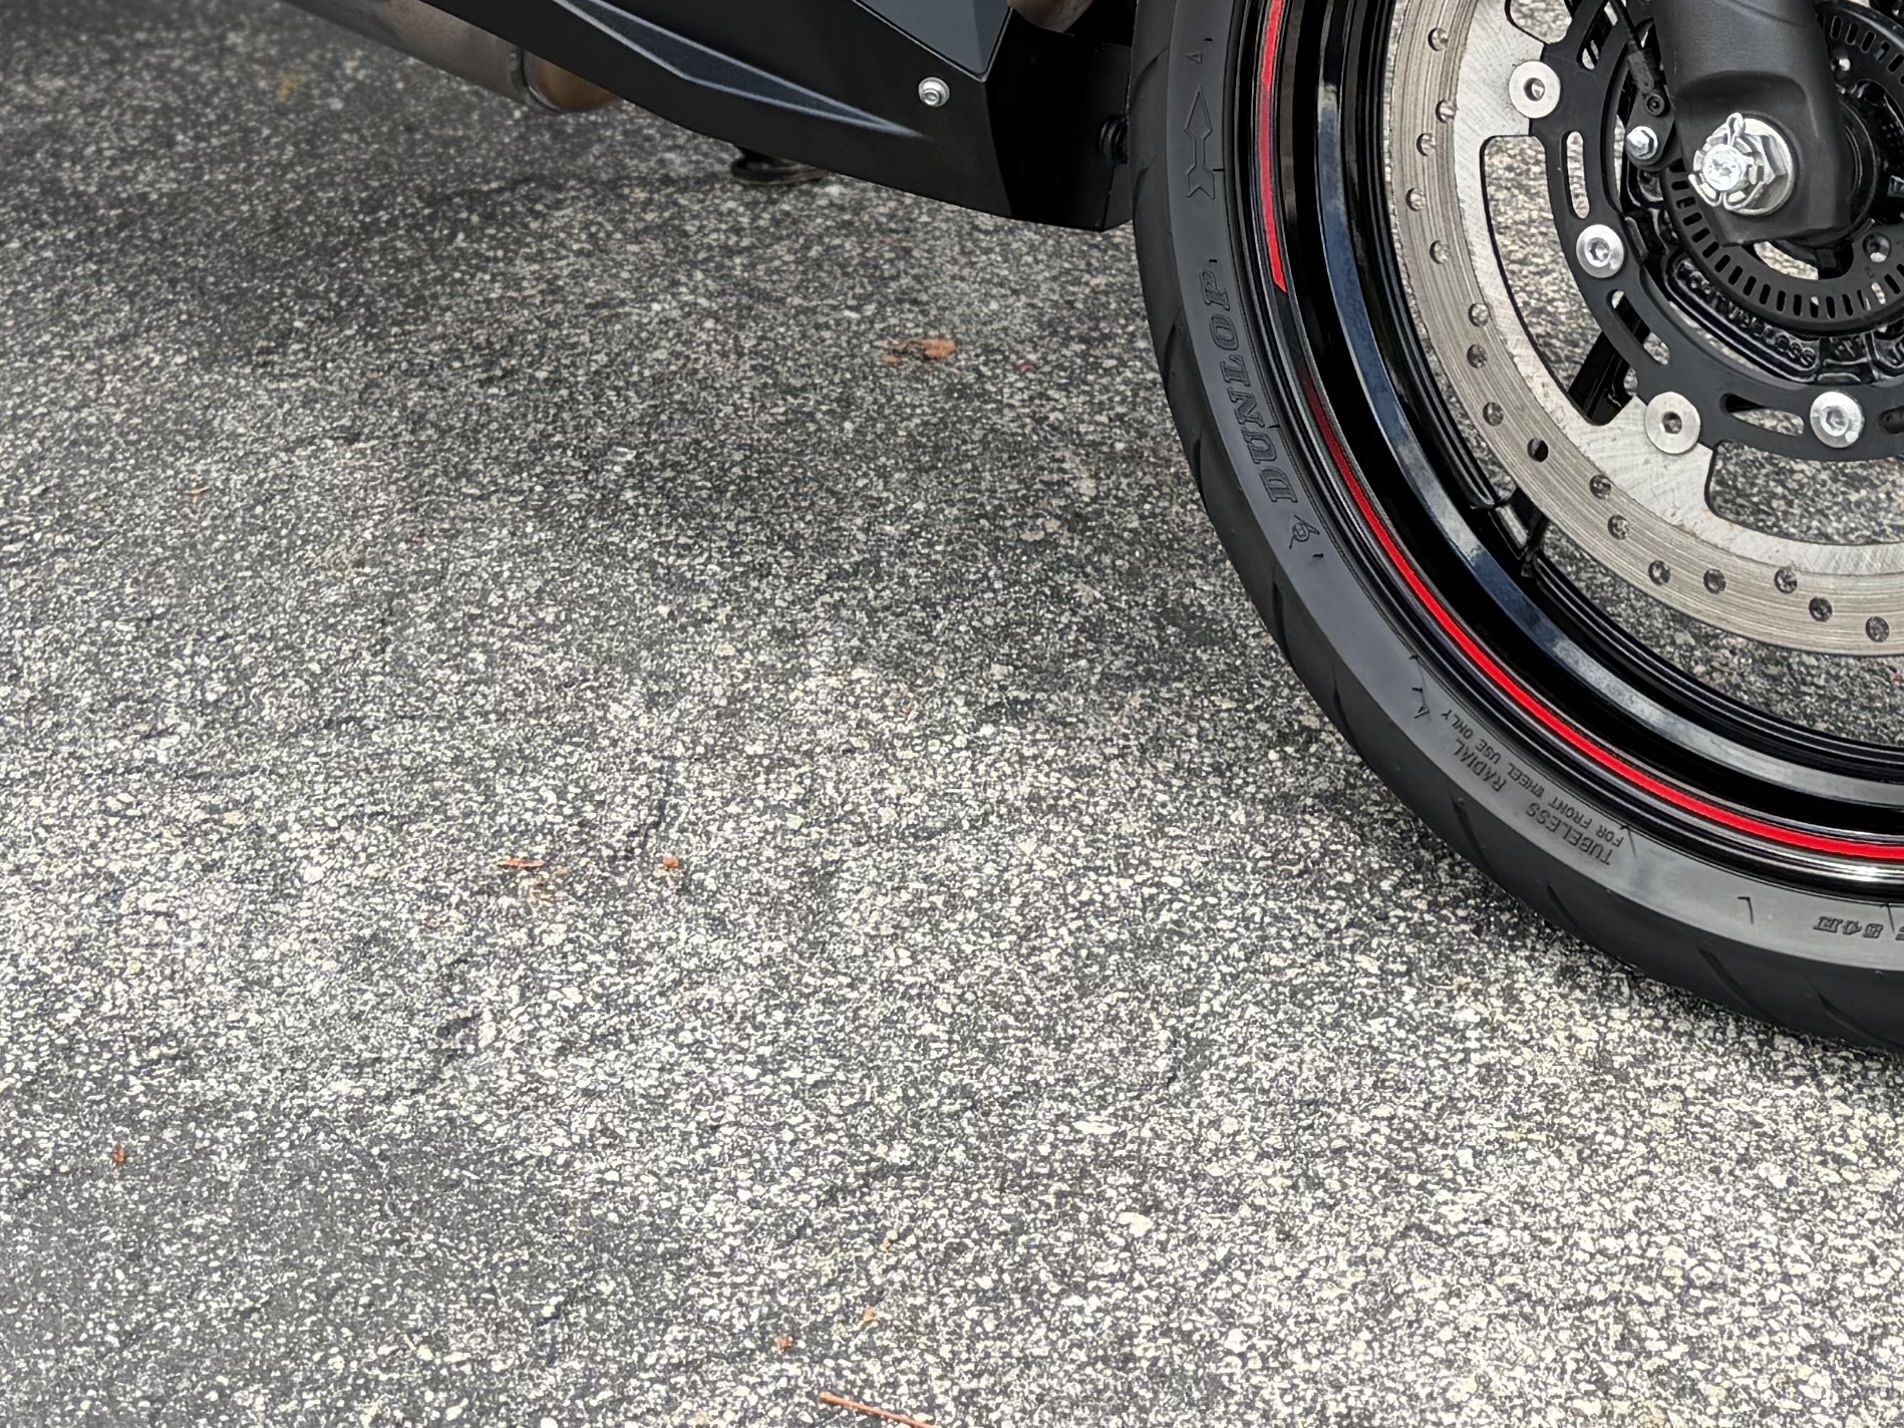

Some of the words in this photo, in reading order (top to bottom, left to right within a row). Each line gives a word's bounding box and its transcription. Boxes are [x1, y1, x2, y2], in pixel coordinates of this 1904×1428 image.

[1201, 266, 1299, 504] DUNLOP
[1440, 708, 1476, 741] ONLY
[1453, 738, 1508, 793] RADIAL
[1477, 739, 1503, 766] USE
[1505, 762, 1547, 799] WHEEL
[1547, 795, 1593, 831] FRONT
[1525, 801, 1614, 866] TUBELESS
[1594, 825, 1625, 850] FOR
